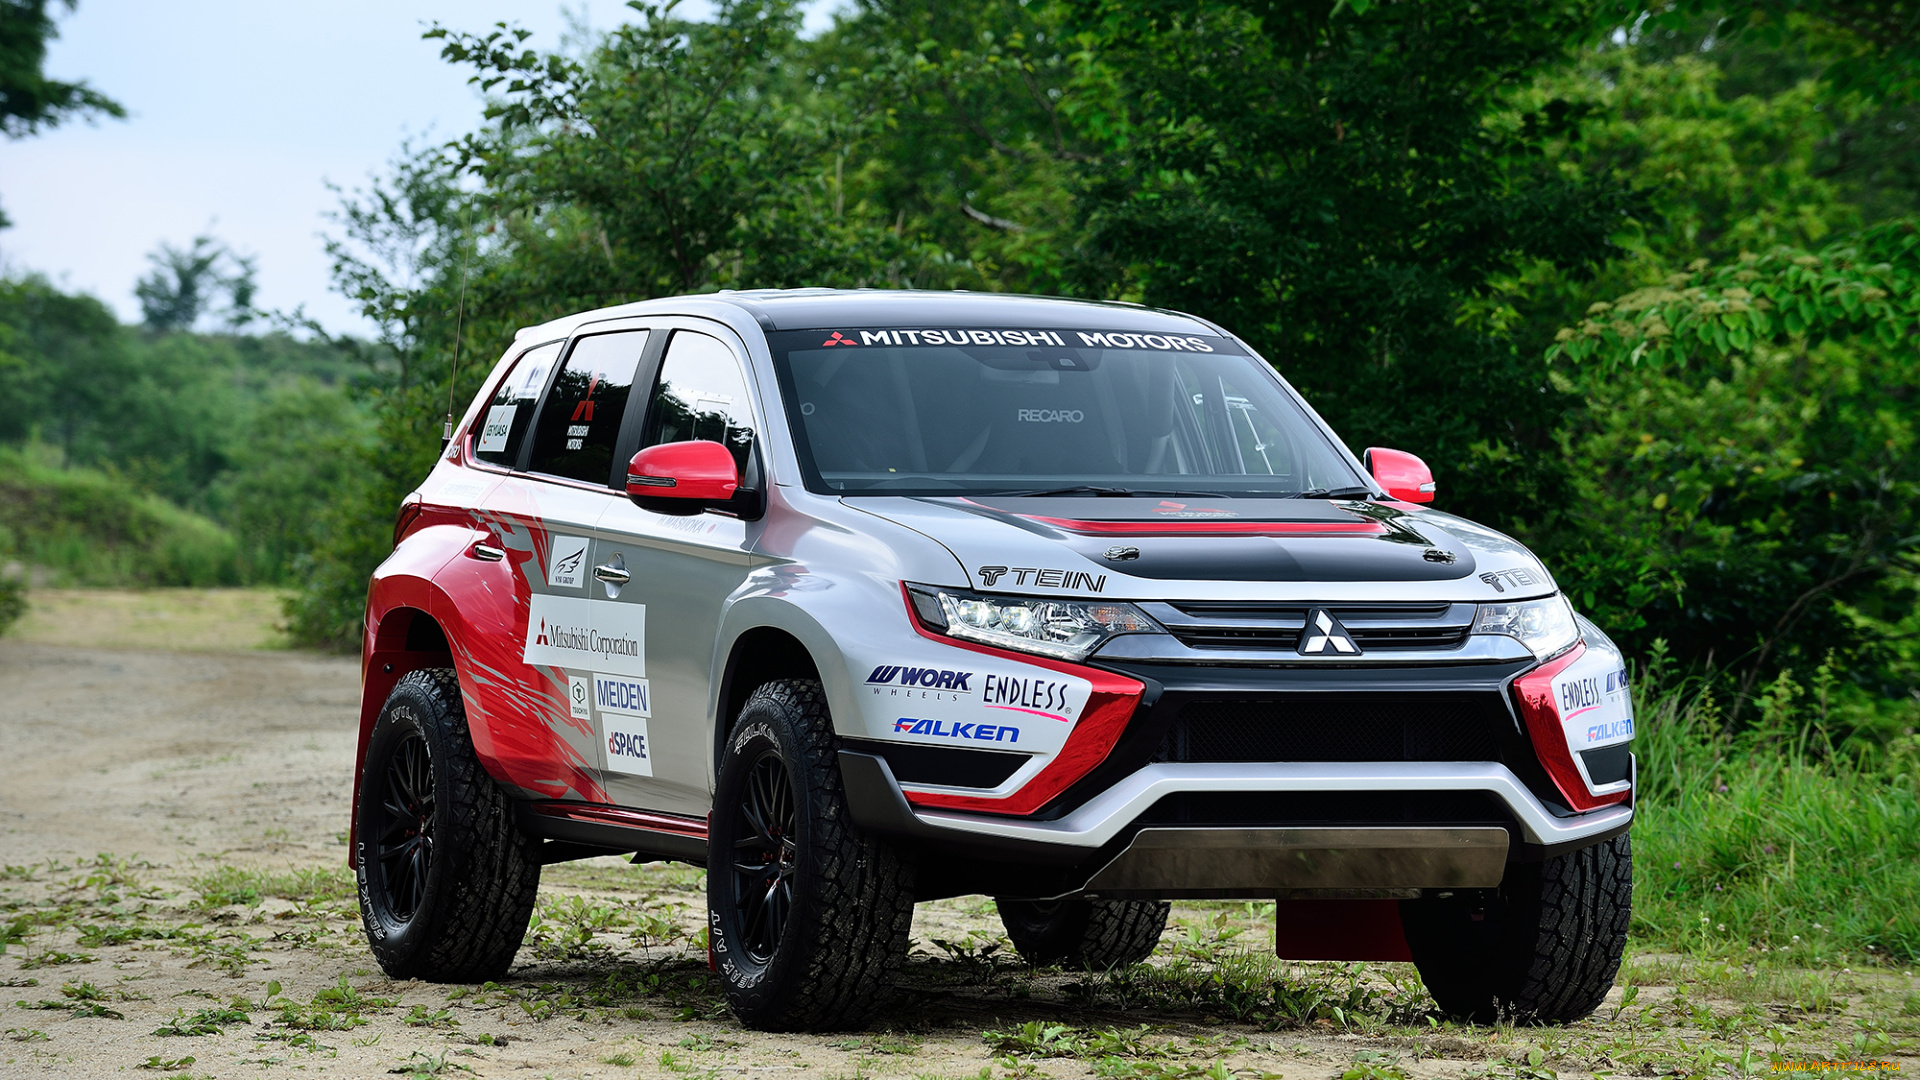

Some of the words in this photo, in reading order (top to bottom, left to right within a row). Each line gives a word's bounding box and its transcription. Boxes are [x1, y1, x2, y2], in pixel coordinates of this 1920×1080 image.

[859, 330, 1066, 347] MITSUBISHI
[1076, 331, 1214, 353] MOTORS
[1018, 408, 1084, 423] RECARO
[1010, 567, 1107, 592] TEIN
[550, 625, 589, 651] Mitsubishi
[589, 630, 638, 660] Corporation
[899, 667, 973, 691] WORK
[597, 679, 647, 712] MEIDEN
[983, 675, 1068, 711] ENDLESS
[1561, 677, 1599, 711] ENDLESS
[892, 717, 1020, 743] FALKEN
[1586, 718, 1633, 742] FALKEN
[608, 731, 646, 759] dSPACE
